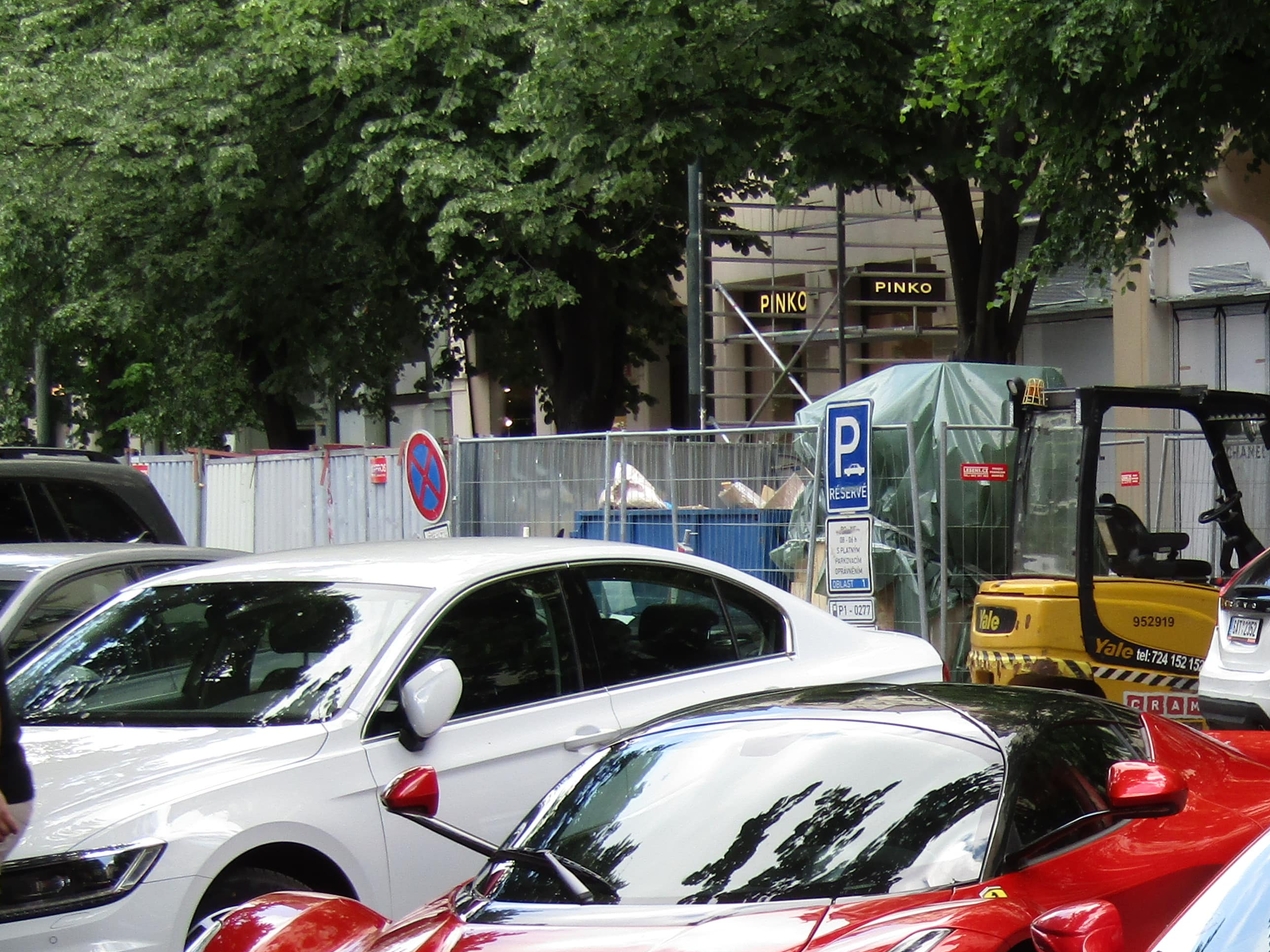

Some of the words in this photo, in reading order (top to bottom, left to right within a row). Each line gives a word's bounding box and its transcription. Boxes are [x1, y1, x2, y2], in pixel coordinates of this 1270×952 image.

[876, 281, 932, 294] PINKO
[760, 290, 808, 314] PINKO
[835, 416, 861, 478] P
[832, 579, 855, 589] OBLAST
[862, 579, 866, 588] 1
[838, 604, 848, 616] P1
[854, 604, 871, 616] 0277
[979, 609, 1000, 631] Yale
[1133, 616, 1175, 628] 952919
[1095, 638, 1134, 659] Yale
[1136, 648, 1150, 662] tel:
[1152, 651, 1169, 666] 724
[1170, 654, 1187, 669] 152
